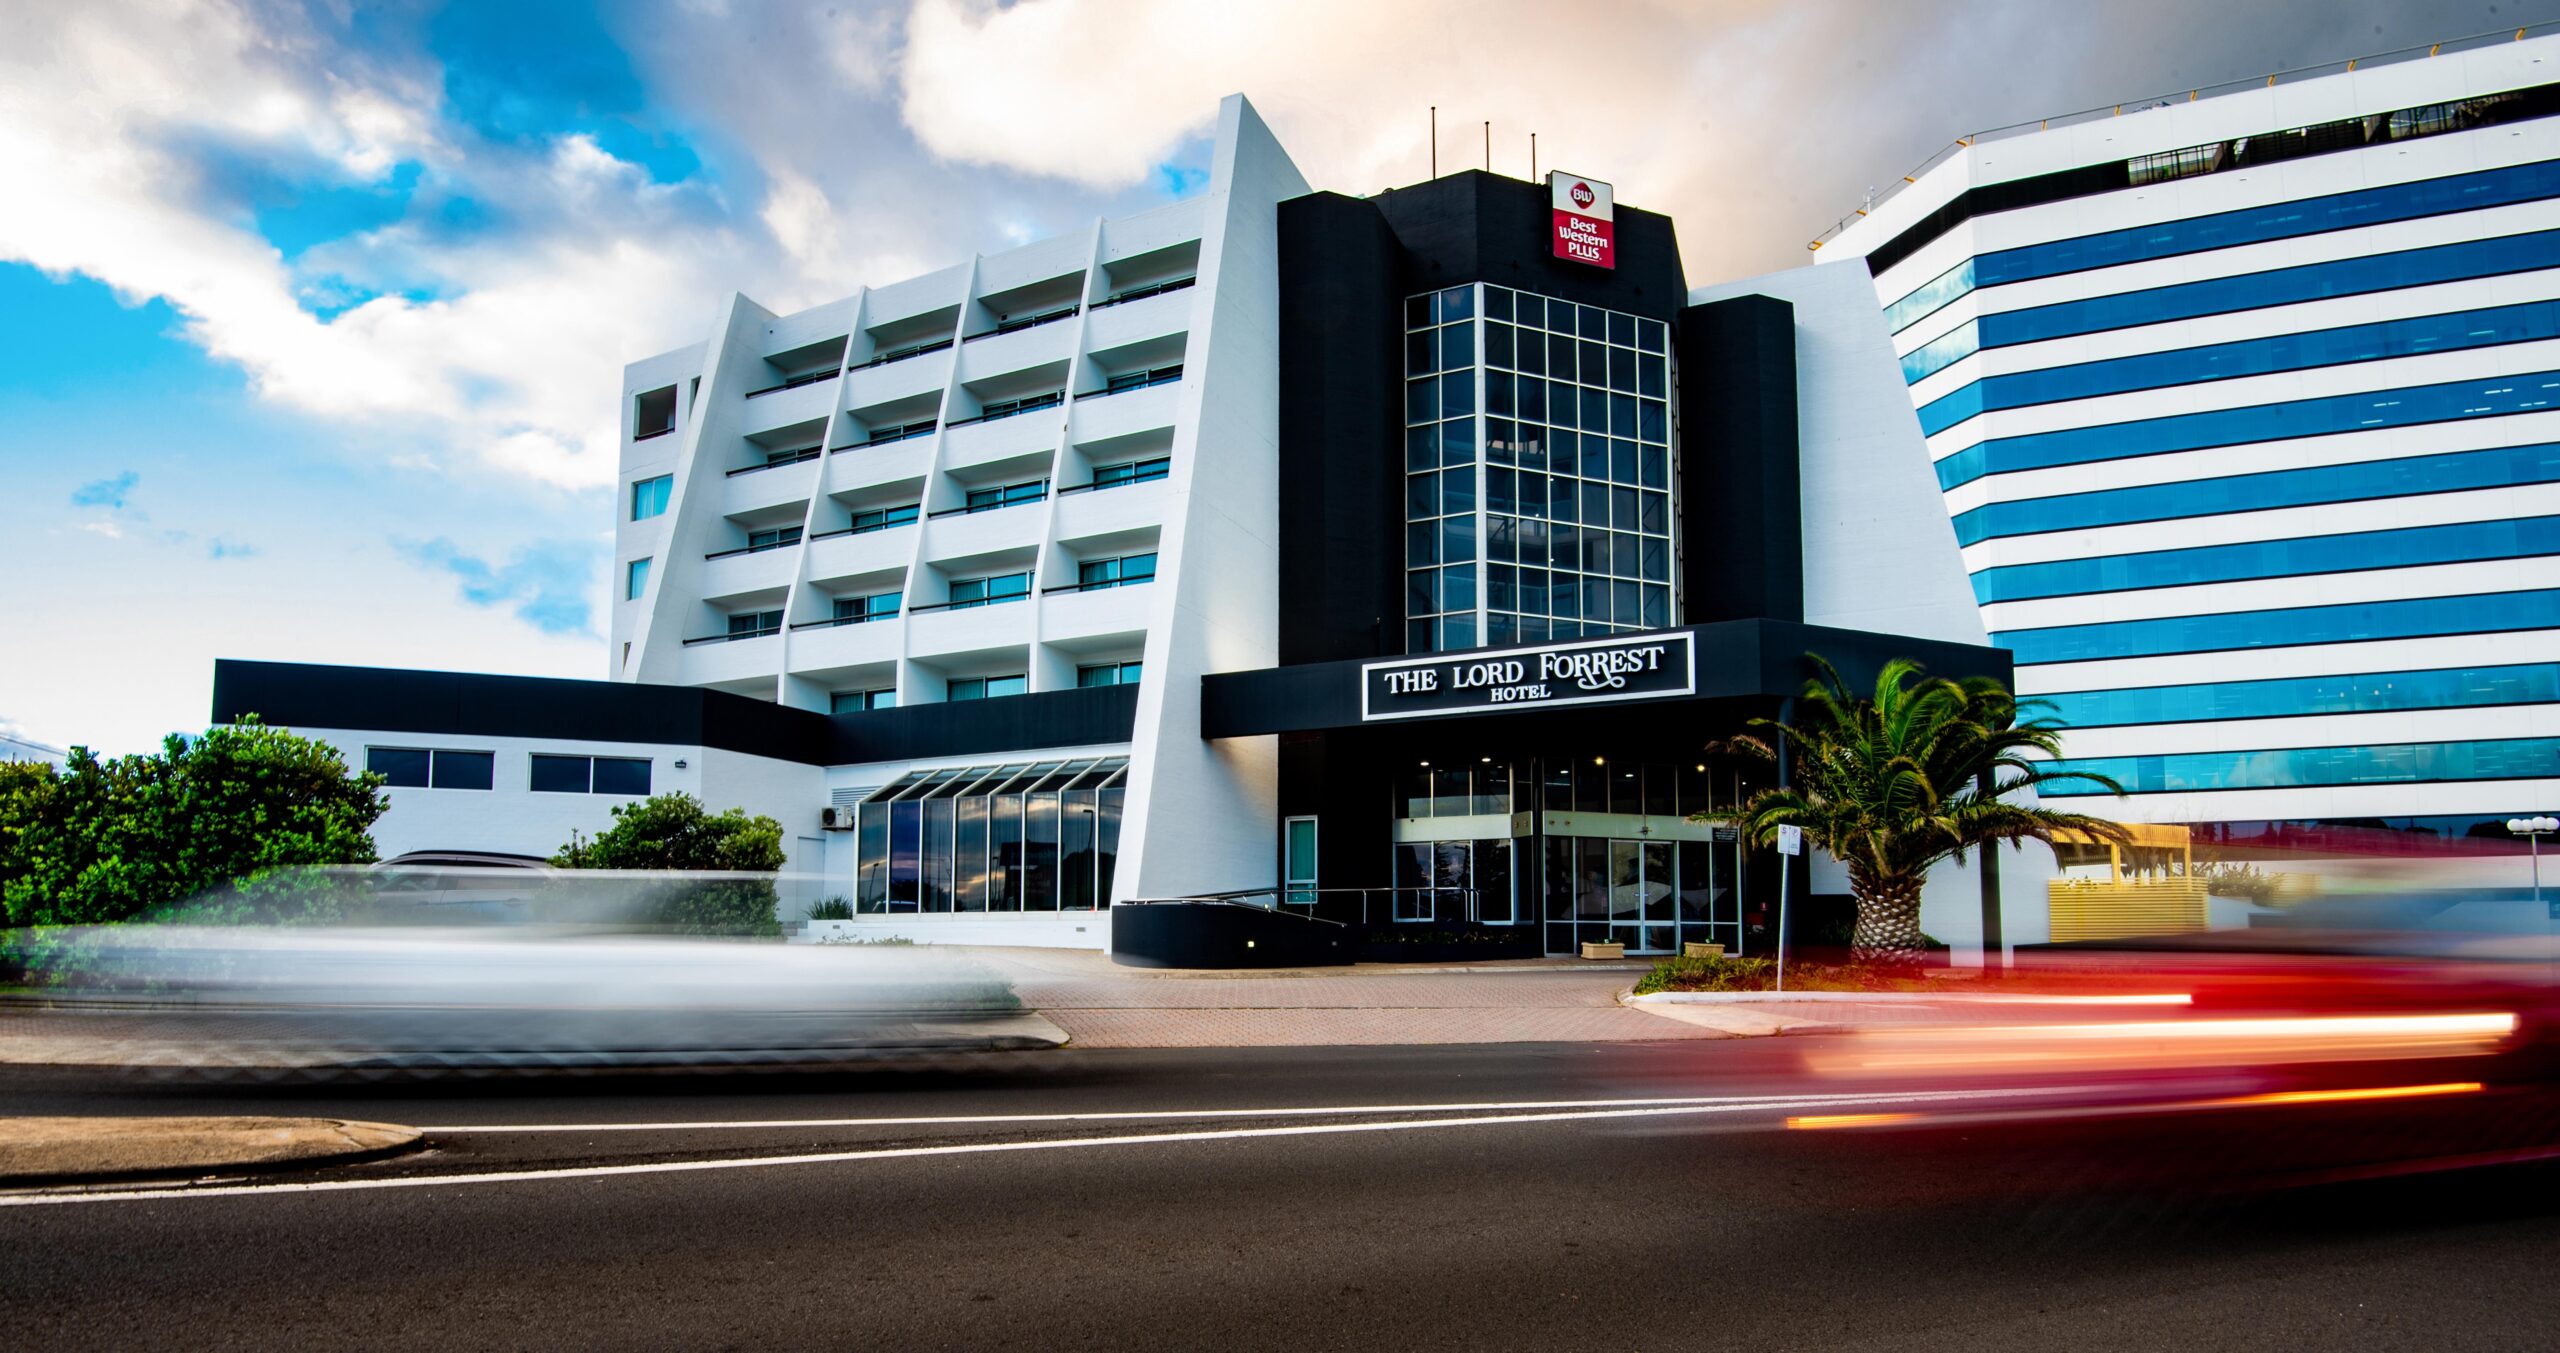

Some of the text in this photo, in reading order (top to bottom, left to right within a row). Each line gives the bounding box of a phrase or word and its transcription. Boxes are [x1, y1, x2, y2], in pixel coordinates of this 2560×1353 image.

[1573, 188, 1592, 203] BW
[1570, 217, 1597, 234] Best
[1559, 226, 1608, 248] Western
[1384, 646, 1664, 694] THE LORD FORREST
[1490, 684, 1551, 702] HOTEL
